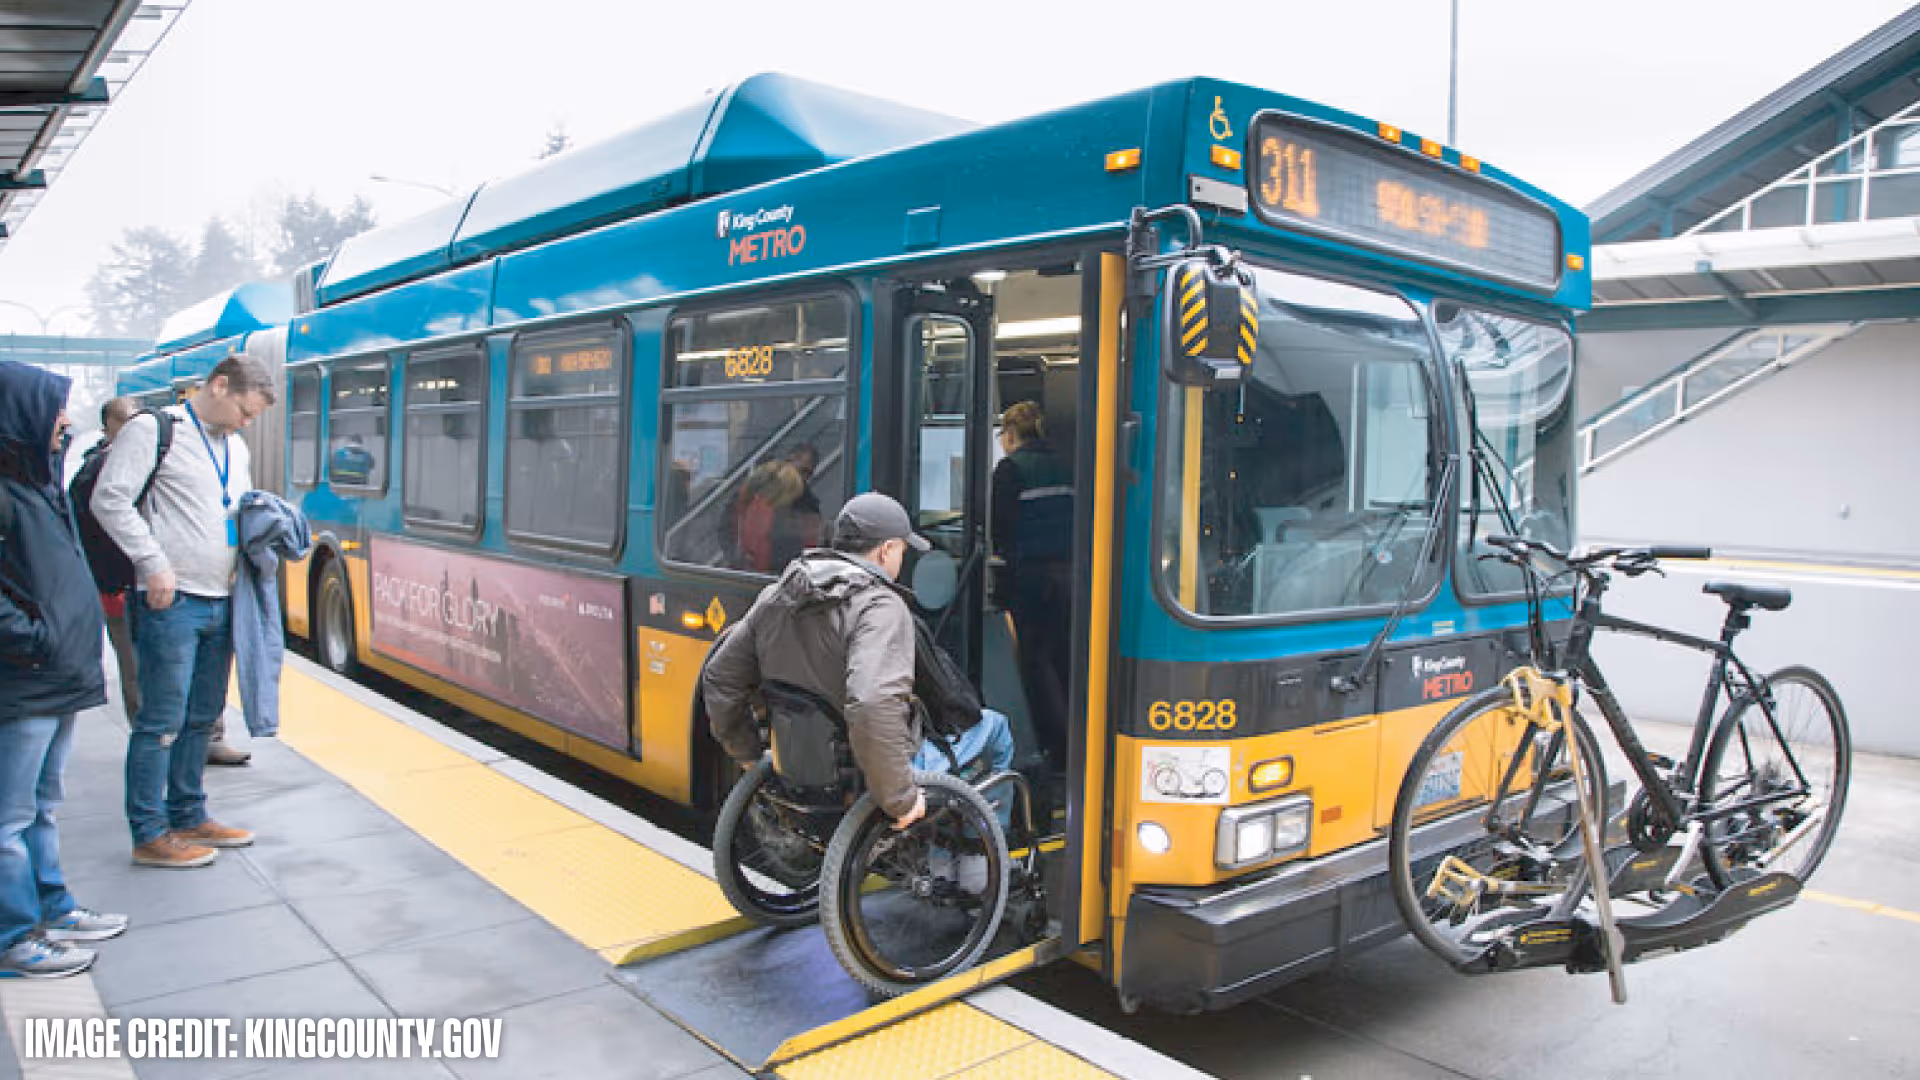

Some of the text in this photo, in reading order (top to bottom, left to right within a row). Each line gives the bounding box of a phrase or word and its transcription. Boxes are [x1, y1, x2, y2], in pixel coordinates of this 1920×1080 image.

[1262, 137, 1320, 217] 311
[732, 204, 794, 231] King County
[728, 225, 806, 266] METRO
[725, 345, 773, 377] 6828
[410, 582, 439, 618] FOR
[443, 590, 500, 638] GLORY
[1423, 670, 1473, 699] METRO
[1148, 699, 1237, 731] 6828
